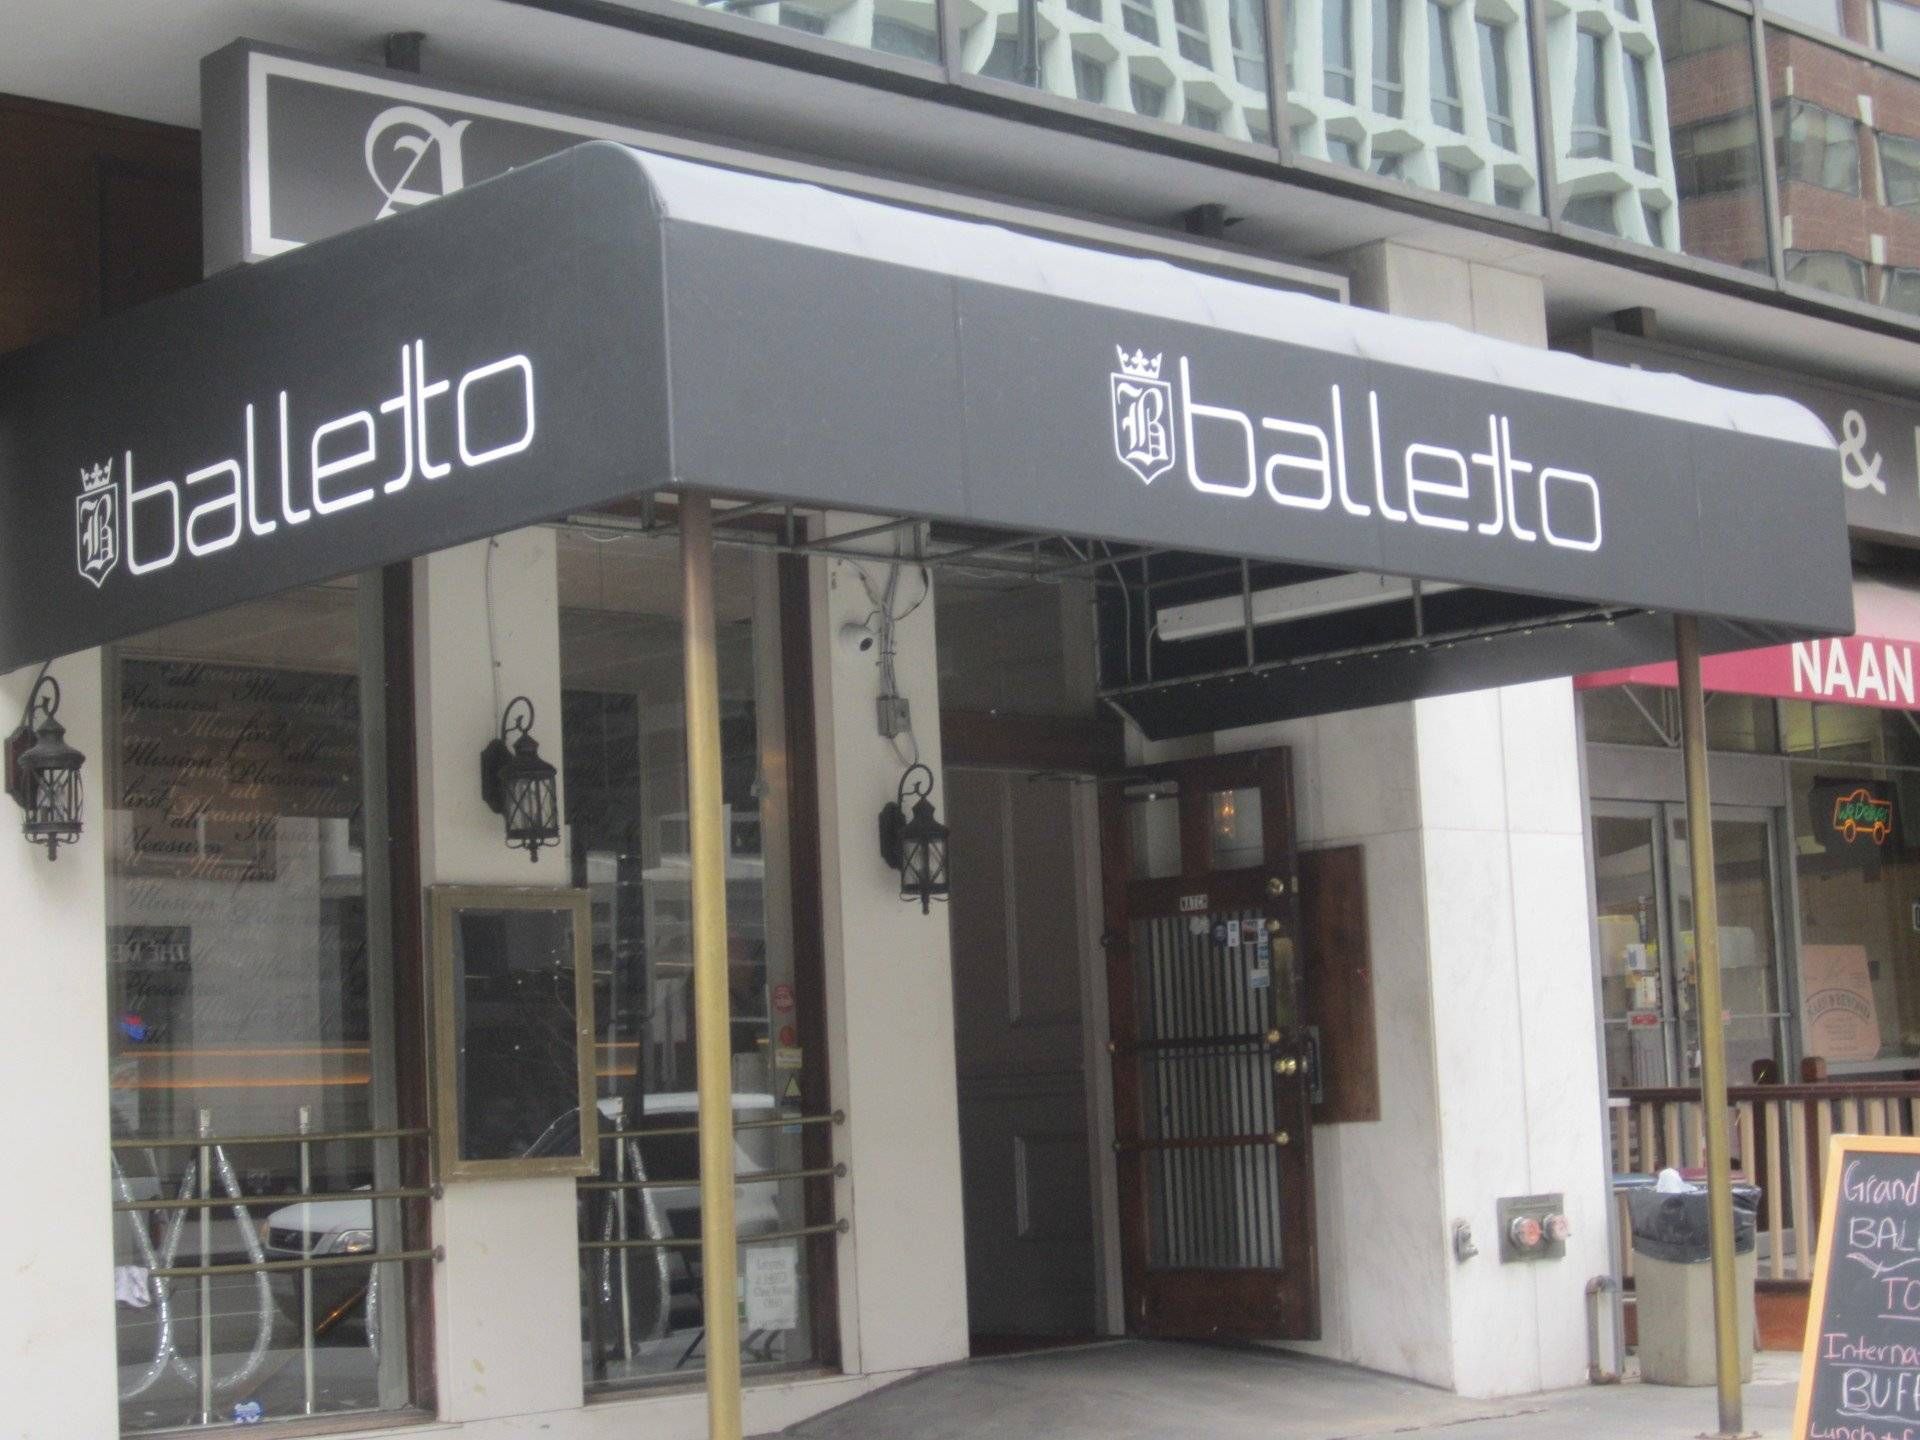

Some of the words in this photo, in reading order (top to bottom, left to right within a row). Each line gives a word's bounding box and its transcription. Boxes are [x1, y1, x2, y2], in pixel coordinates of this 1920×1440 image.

[125, 339, 535, 576] balletto
[1180, 356, 1602, 552] balletto
[1792, 637, 1915, 705] NAAN
[1843, 1160, 1920, 1206] Grand
[1849, 1216, 1920, 1251] BAL
[1823, 1333, 1920, 1365] Interna
